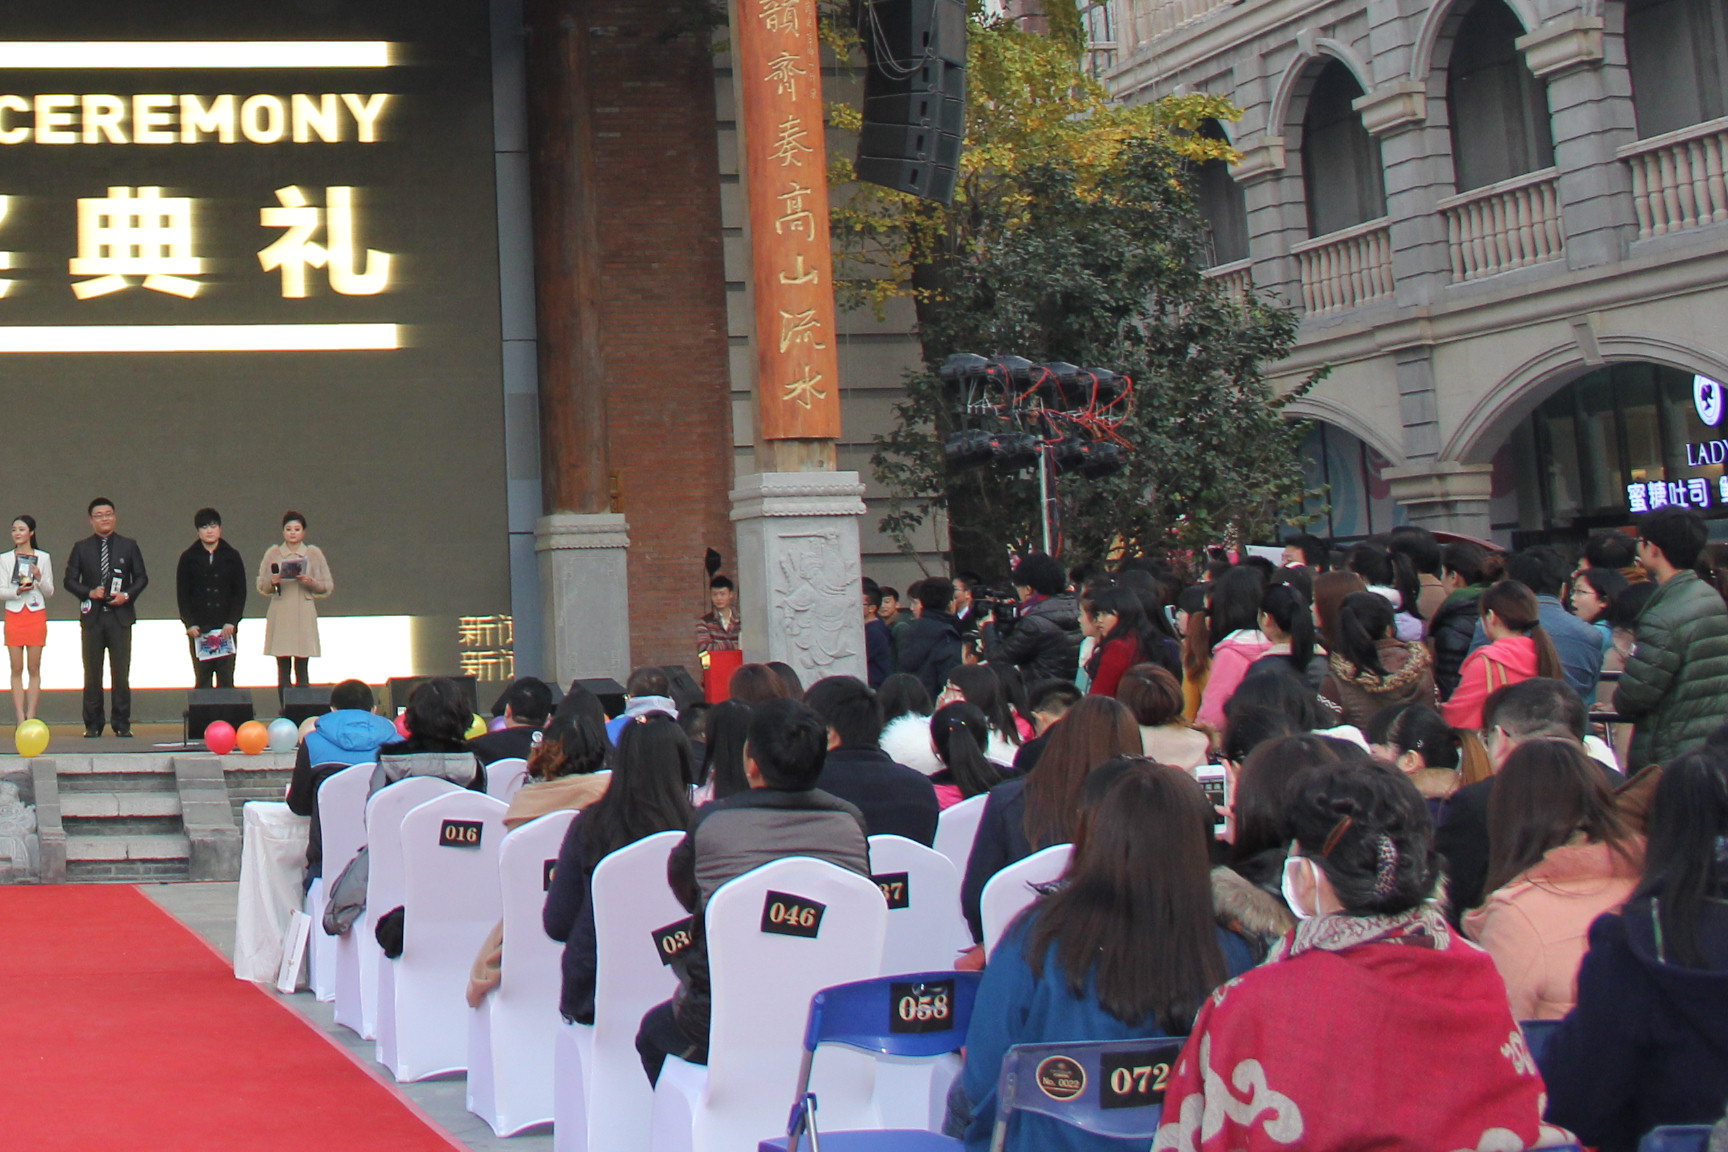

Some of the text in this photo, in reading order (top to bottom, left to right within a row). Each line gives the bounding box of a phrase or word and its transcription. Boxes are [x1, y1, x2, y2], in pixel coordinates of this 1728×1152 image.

[1627, 477, 1709, 513] 蜜糖吐司
[445, 825, 478, 843] 016
[769, 901, 817, 927] 046
[662, 929, 693, 955] 03
[898, 993, 949, 1022] 058
[1110, 1062, 1170, 1095] 072
